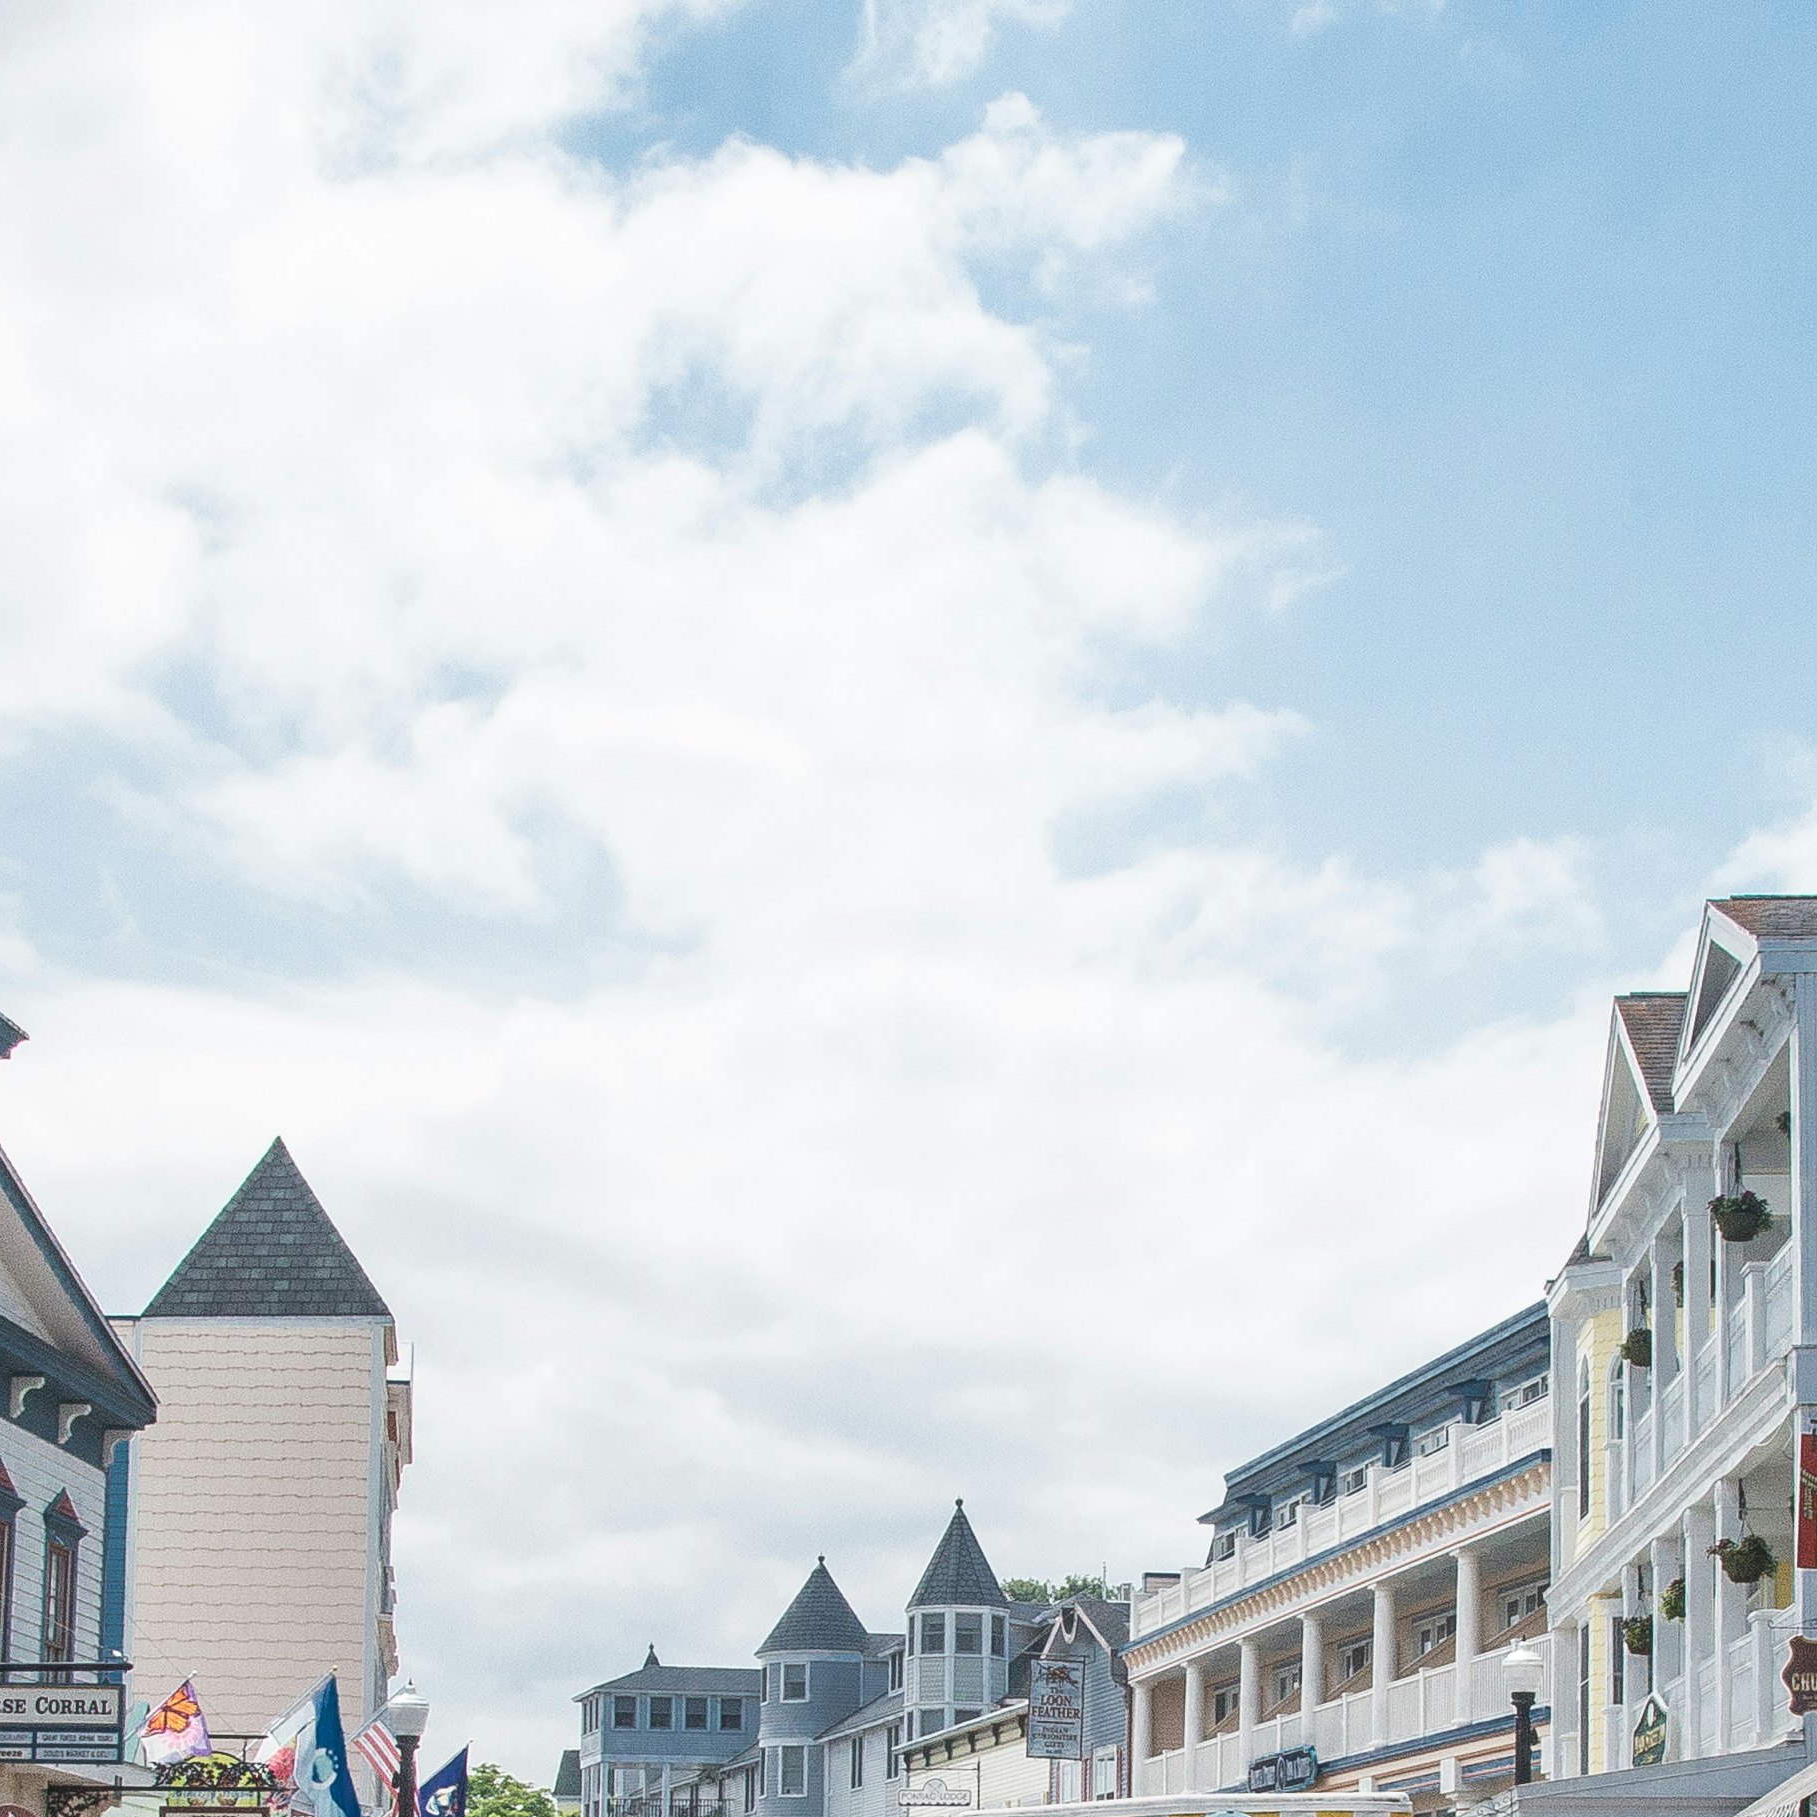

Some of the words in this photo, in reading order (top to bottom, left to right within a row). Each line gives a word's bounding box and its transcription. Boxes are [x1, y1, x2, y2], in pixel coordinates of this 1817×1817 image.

[35, 1696, 113, 1715] CORRAL
[1040, 1694, 1072, 1706] LOON
[1031, 1706, 1081, 1719] FEATHER
[940, 1792, 968, 1800] LODGE
